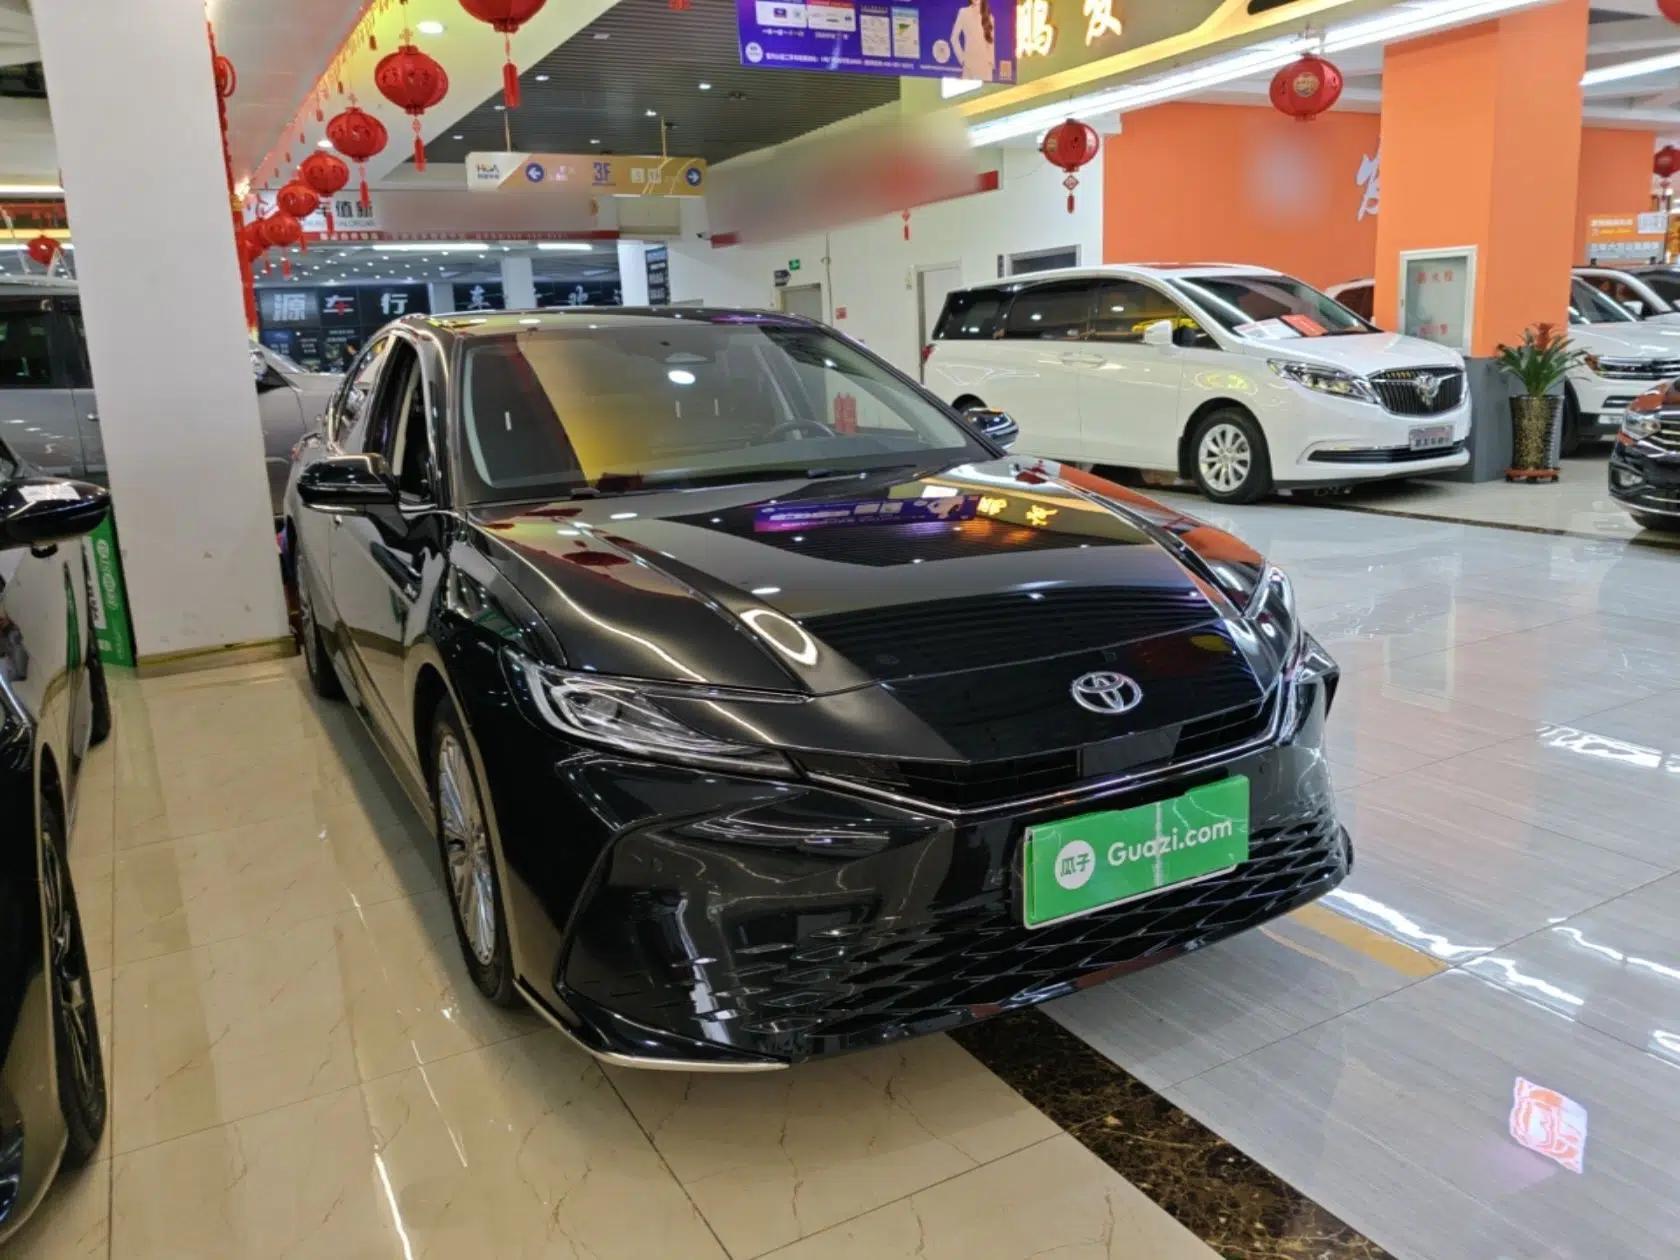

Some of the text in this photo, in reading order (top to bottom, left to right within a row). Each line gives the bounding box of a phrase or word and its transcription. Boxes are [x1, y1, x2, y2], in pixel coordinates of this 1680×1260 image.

[593, 162, 611, 181] 3F
[1107, 820, 1233, 866] Guazi.com
[1060, 852, 1091, 877] 瓜子
